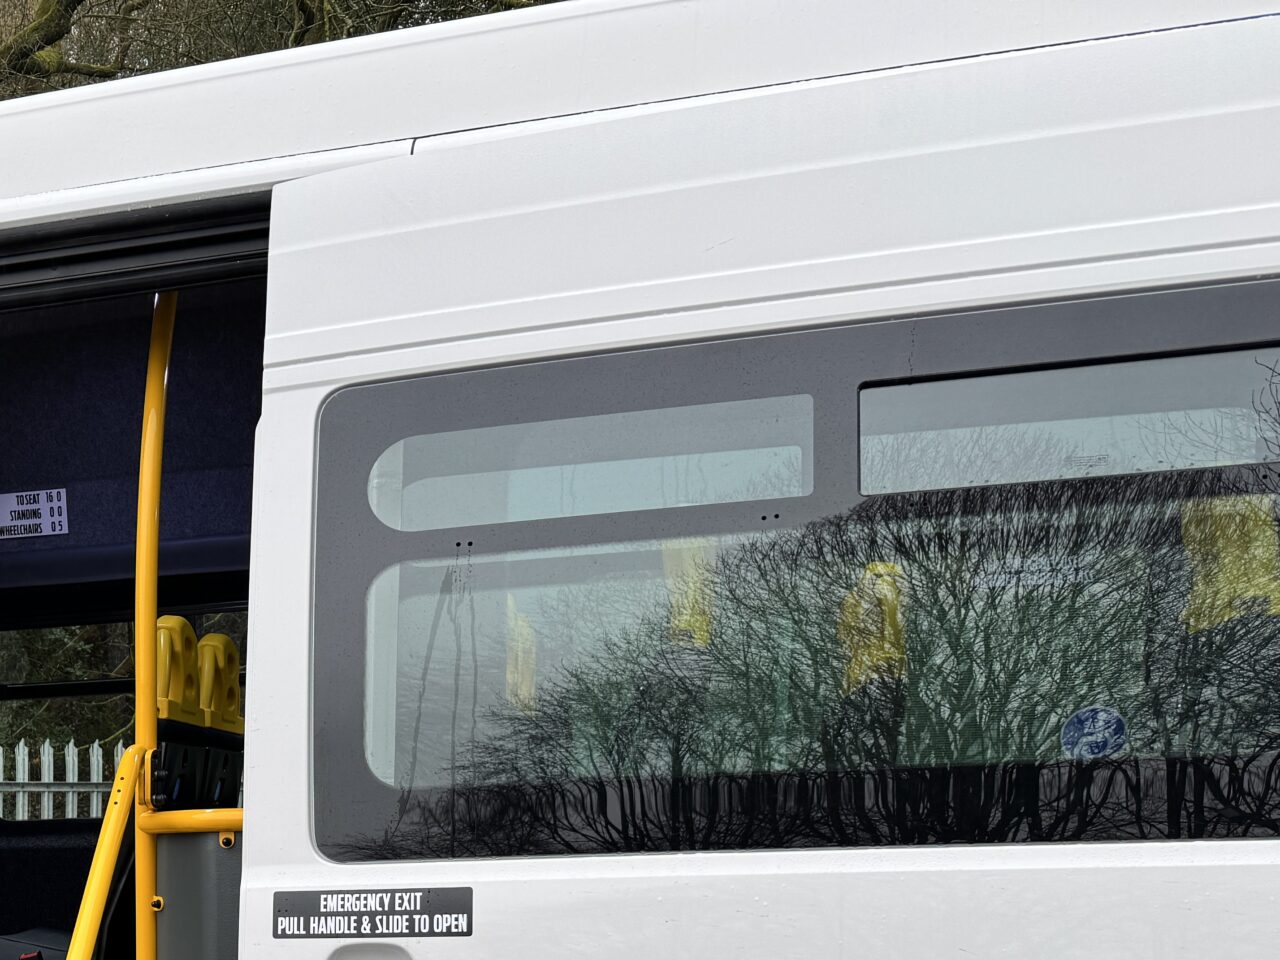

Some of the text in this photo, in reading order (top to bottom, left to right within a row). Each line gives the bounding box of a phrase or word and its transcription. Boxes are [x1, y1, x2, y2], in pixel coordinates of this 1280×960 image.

[45, 491, 53, 503] 16
[10, 508, 42, 521] STANDING
[0, 523, 42, 537] WHEELCHAIRS
[320, 892, 422, 913] EMERGENCY EXIT
[277, 913, 468, 935] PULL HANDLE & SLIDE TO OPEN
